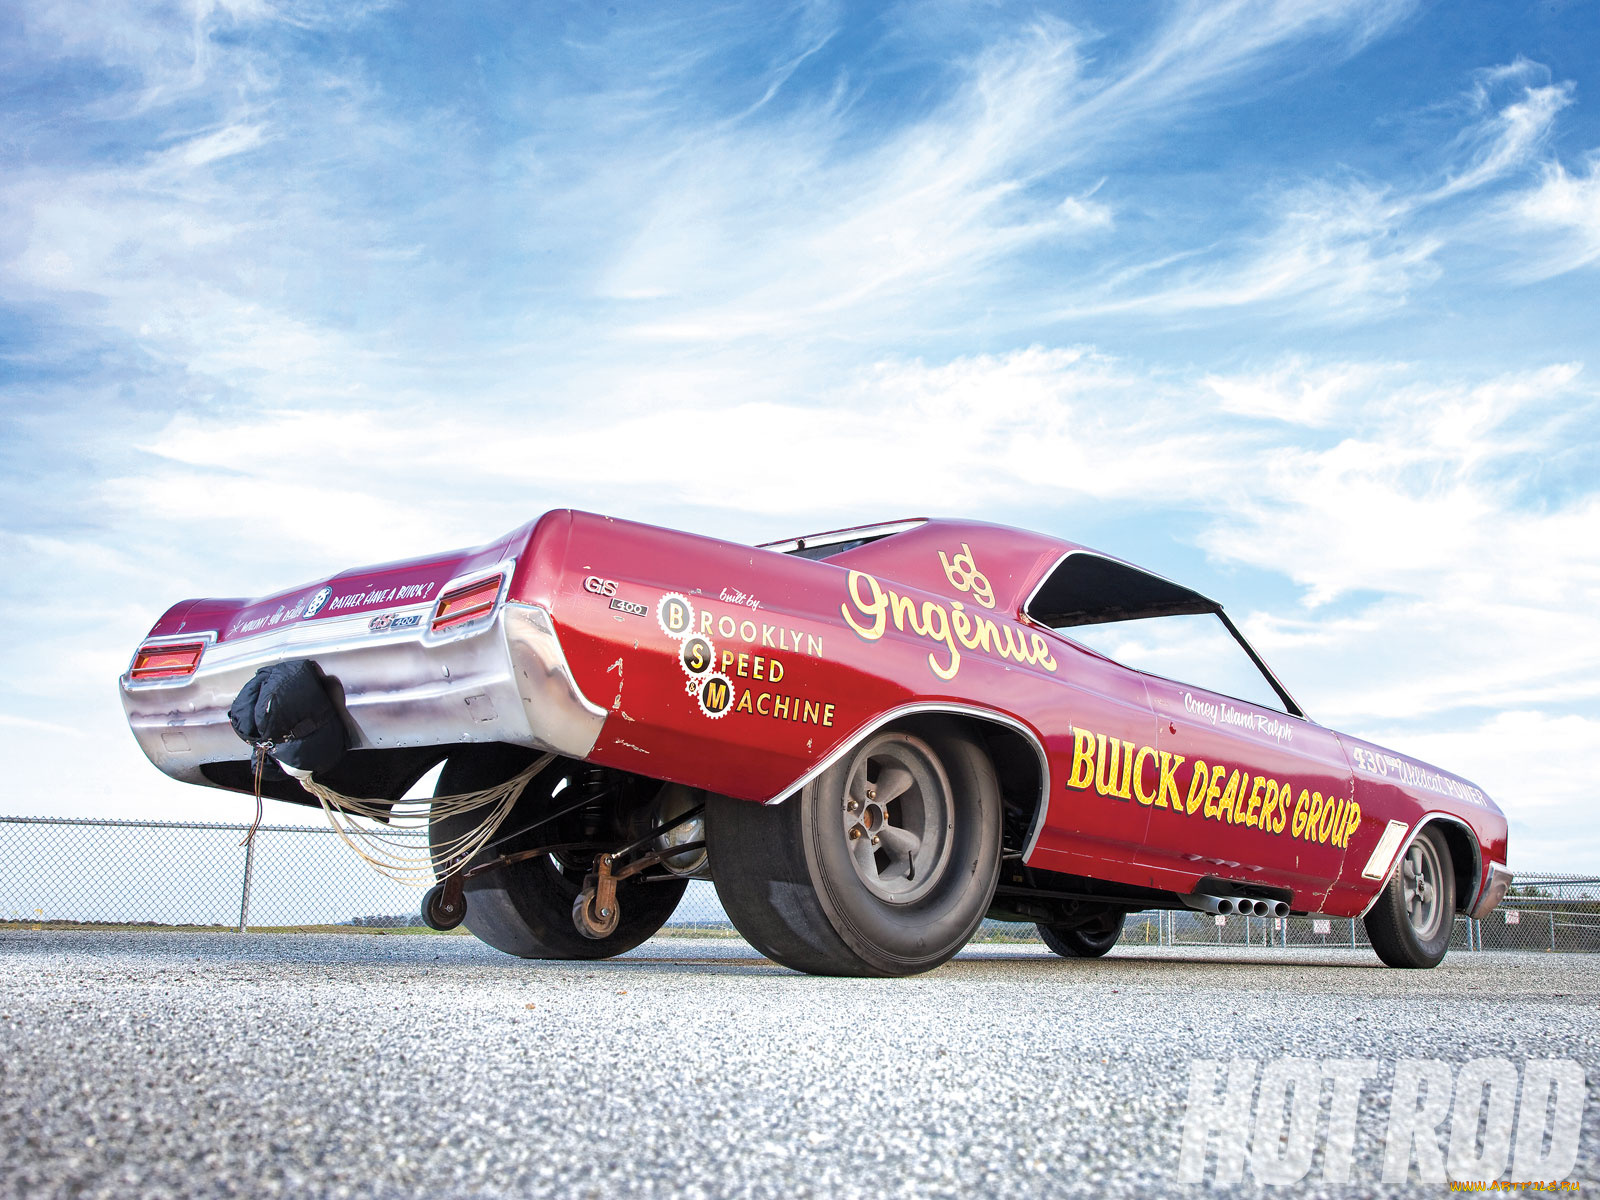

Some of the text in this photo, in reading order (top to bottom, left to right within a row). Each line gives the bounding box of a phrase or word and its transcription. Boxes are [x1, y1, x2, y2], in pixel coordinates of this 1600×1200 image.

[328, 592, 366, 611] RATHER
[362, 588, 391, 606] HAVE
[385, 587, 397, 602] A
[583, 575, 618, 597] GS
[719, 586, 747, 605] built
[609, 598, 649, 617] 400
[668, 597, 824, 658] BROOKLYN
[690, 642, 785, 684] SPEED
[706, 682, 836, 727] MACHINE
[1219, 703, 1256, 731] Island
[1066, 726, 1362, 849] BUICK DEALERS GROUP
[1353, 746, 1388, 777] 430
[1445, 776, 1489, 808] POWER
